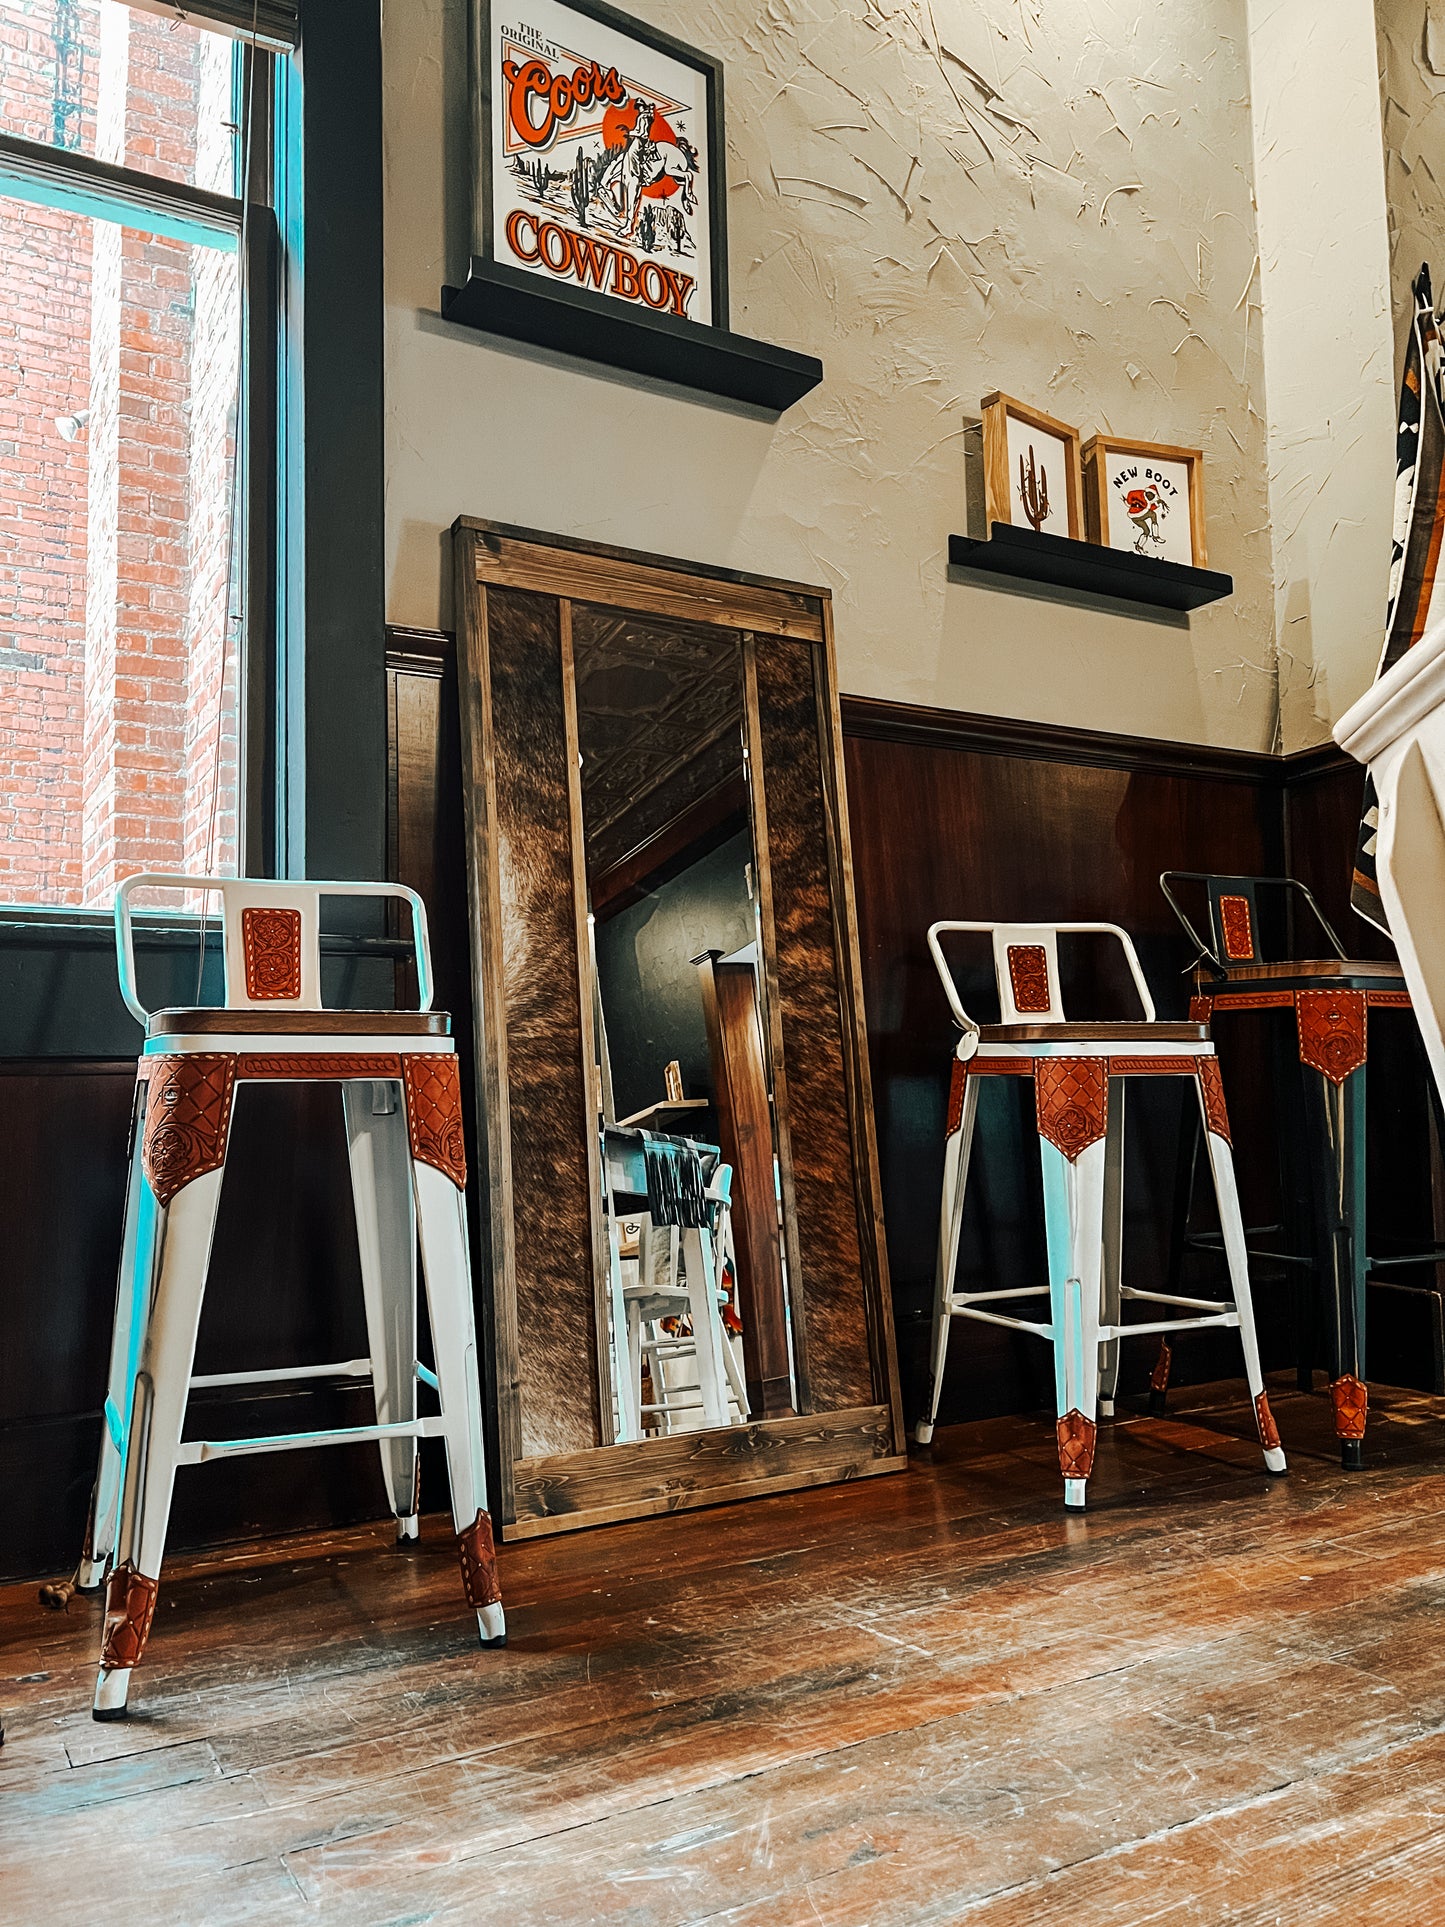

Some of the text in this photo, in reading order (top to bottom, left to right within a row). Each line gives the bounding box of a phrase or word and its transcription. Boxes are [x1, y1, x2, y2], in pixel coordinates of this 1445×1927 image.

[501, 25, 559, 59] ORIGINAL
[518, 21, 543, 41] THE
[502, 60, 627, 149] Coors
[506, 210, 695, 318] COWBOY
[1113, 466, 1179, 496] NEW BOOT
